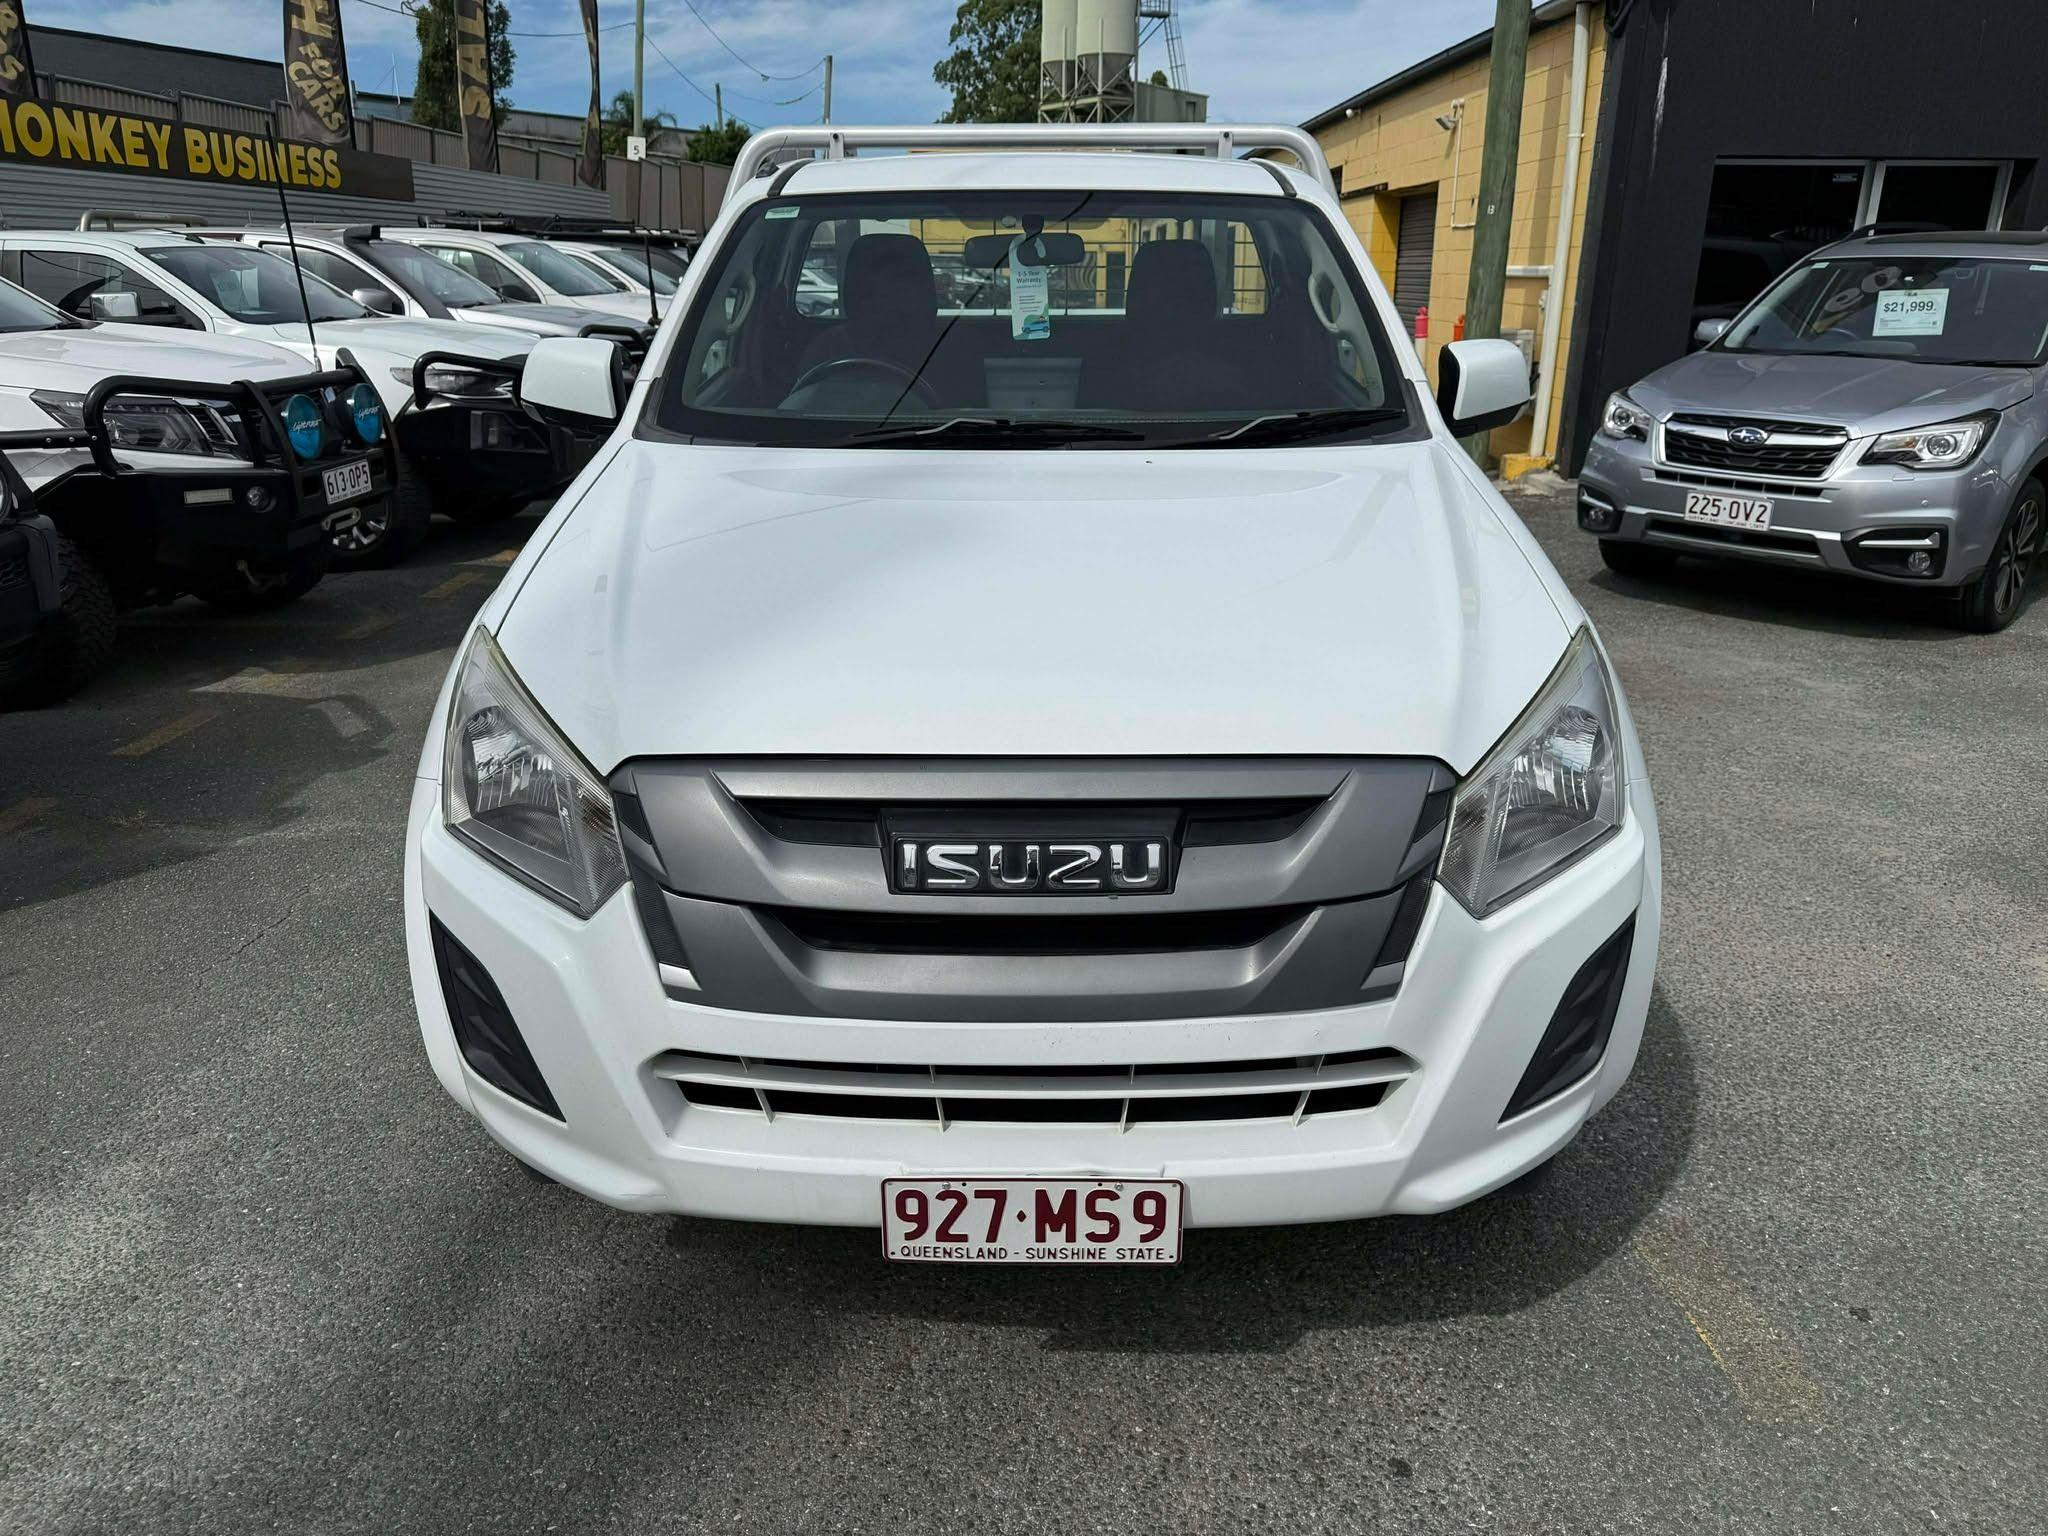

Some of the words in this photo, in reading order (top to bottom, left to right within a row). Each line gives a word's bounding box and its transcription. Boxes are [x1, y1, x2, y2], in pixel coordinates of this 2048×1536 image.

[298, 42, 345, 102] FOR
[456, 0, 491, 121] SAL
[288, 61, 347, 132] CARS
[184, 128, 342, 190] BUSINESS
[902, 843, 1161, 890] ISUZU
[901, 1246, 1008, 1260] QUEENSLAND
[1025, 1247, 1107, 1260] SUNSHINE
[1116, 1247, 1165, 1260] STATE
